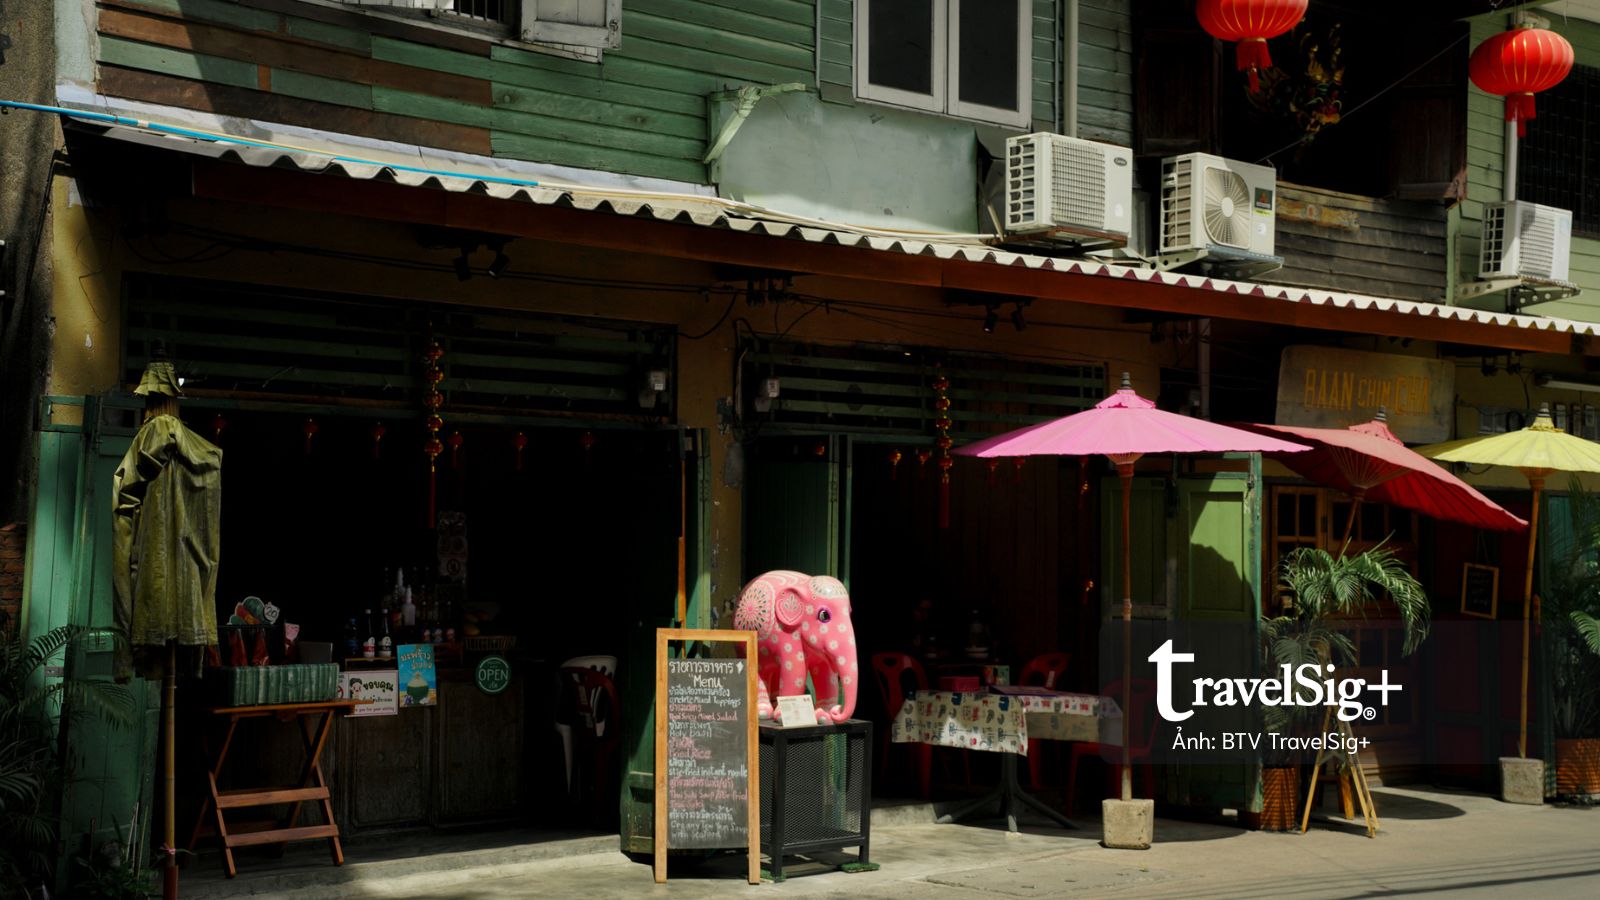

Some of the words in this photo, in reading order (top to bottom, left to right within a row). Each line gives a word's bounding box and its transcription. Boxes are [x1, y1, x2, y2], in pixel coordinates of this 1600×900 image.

[1304, 369, 1355, 411] BAAN
[669, 661, 734, 674] รายการอาหาร
[478, 668, 509, 681] OPEN
[363, 681, 394, 693] ขอบคุณ
